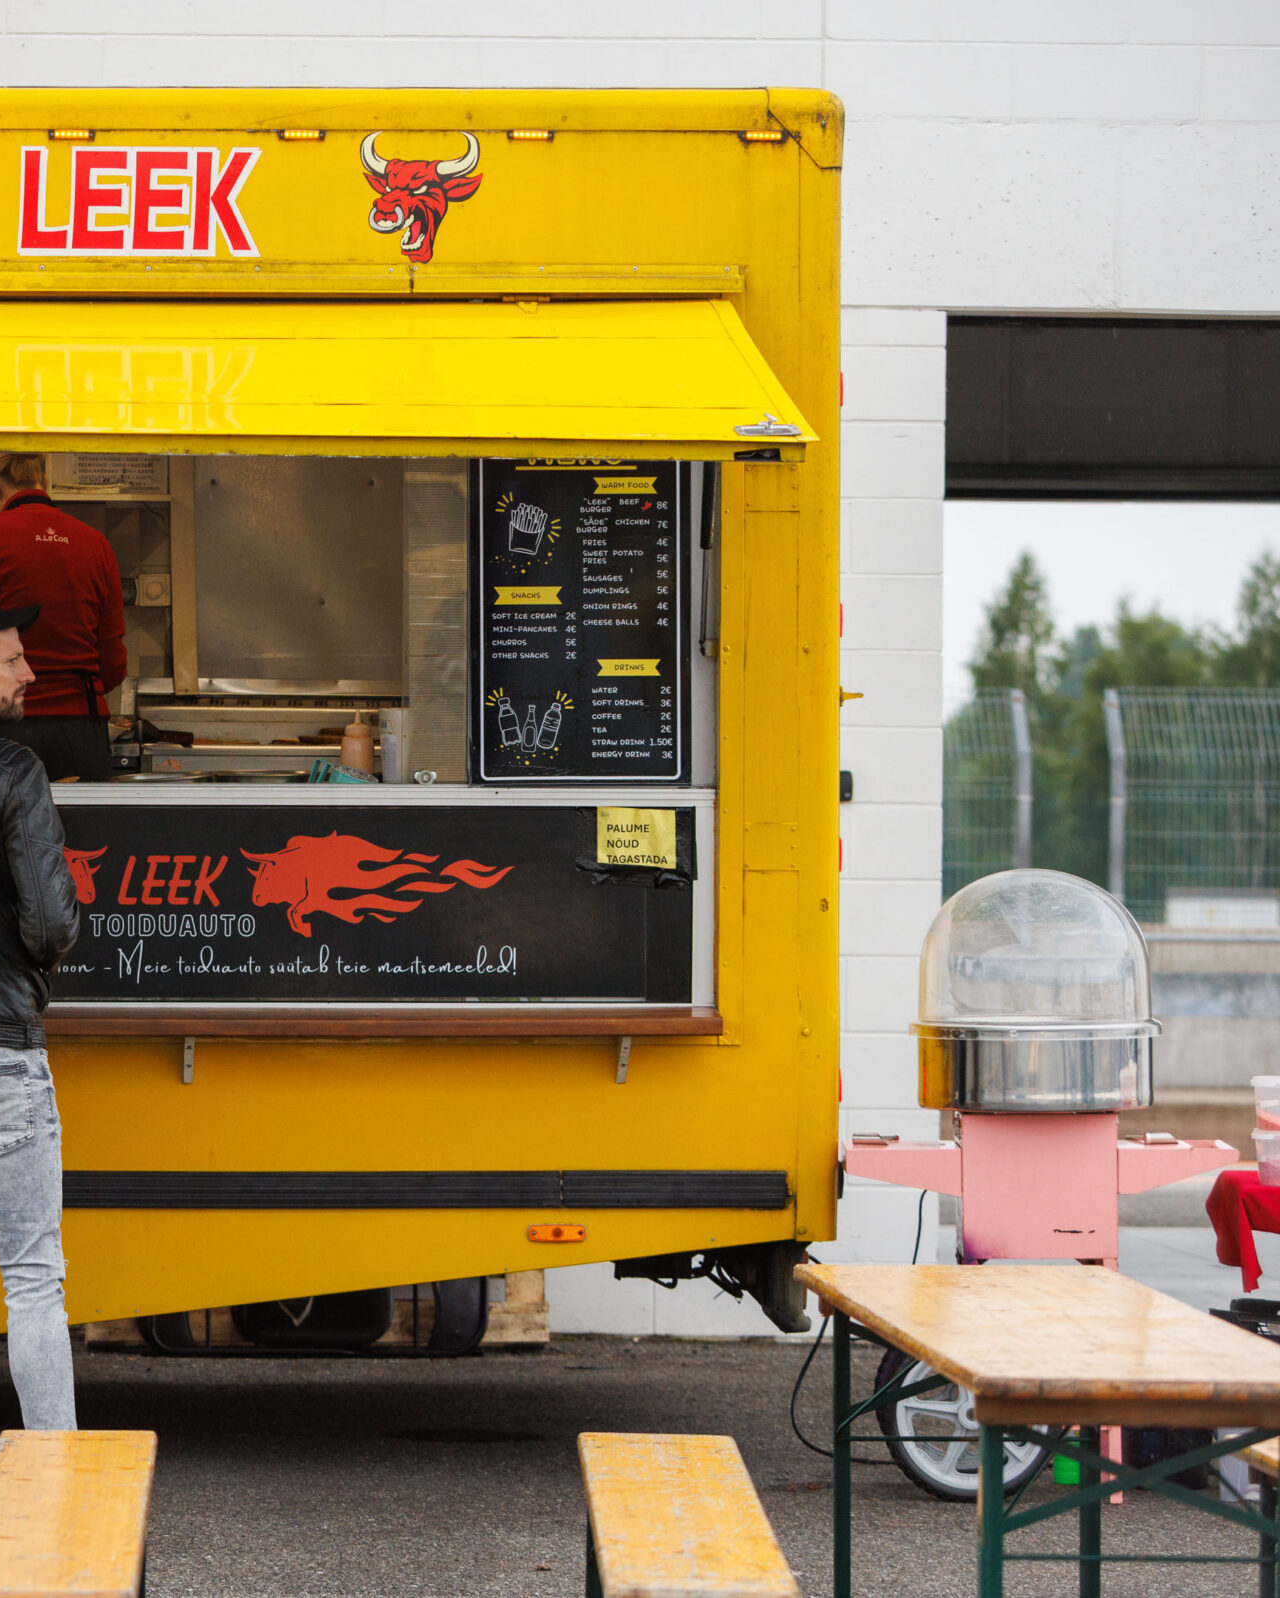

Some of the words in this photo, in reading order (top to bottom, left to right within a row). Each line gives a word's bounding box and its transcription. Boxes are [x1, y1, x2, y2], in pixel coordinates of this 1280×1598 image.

[17, 146, 262, 257] LEEK
[656, 501, 668, 510] 8€
[656, 520, 668, 529] 7€
[656, 538, 668, 547] 4€
[656, 554, 668, 562] 5€
[656, 570, 668, 578] 5€
[656, 586, 669, 595] 5€
[656, 602, 669, 611] 4€
[565, 612, 577, 620] 2€
[656, 618, 669, 627] 4€
[565, 625, 577, 633] 4€
[565, 638, 577, 647] 5€
[565, 652, 577, 660] 2€
[660, 686, 672, 695] 2€
[660, 699, 672, 708] 3€
[660, 712, 672, 720] 2€
[660, 725, 672, 733] 2€
[661, 750, 673, 759] 3€
[606, 823, 650, 833] PALUME
[606, 854, 668, 864] TAGASTADA
[118, 855, 228, 907] LEEK
[89, 913, 256, 937] TOIDUAUTO
[118, 939, 171, 985] Meie
[176, 945, 262, 976] toiduauto
[270, 944, 330, 975] süütab
[335, 956, 371, 975] teie
[377, 945, 517, 976] maitsemeeled!
